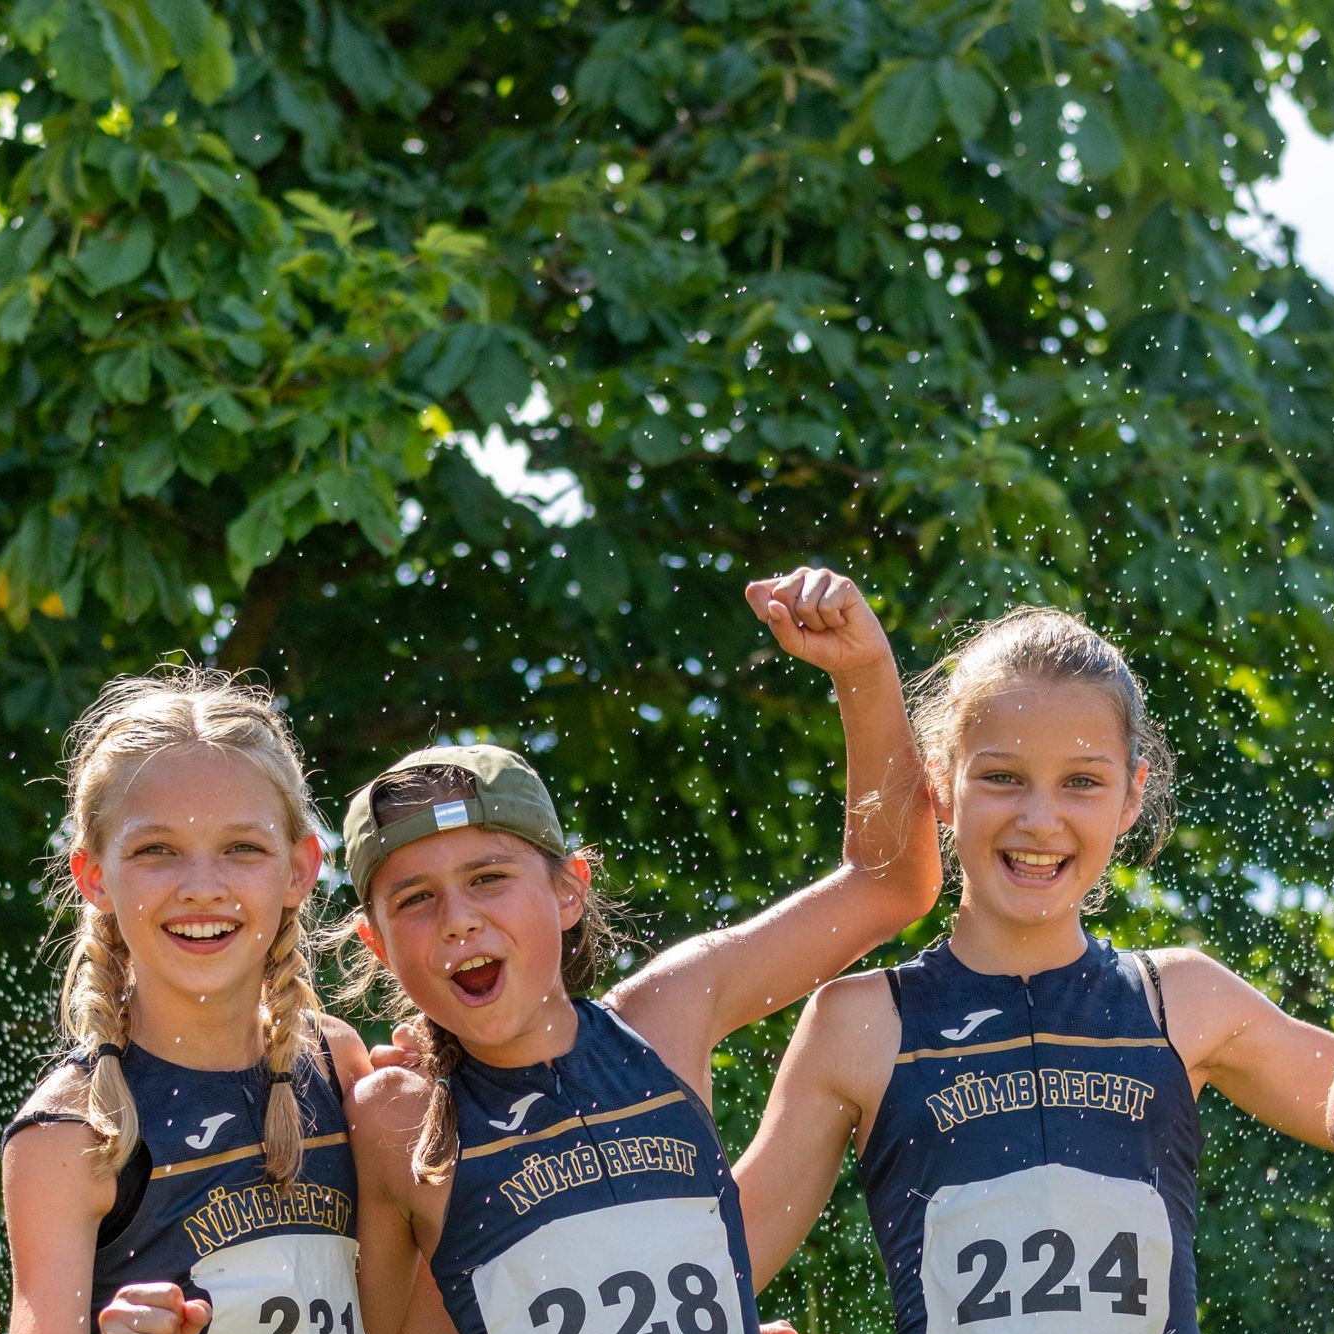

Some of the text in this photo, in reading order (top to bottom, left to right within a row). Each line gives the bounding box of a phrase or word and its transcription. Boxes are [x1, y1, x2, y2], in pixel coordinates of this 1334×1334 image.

[926, 1068, 1155, 1133] NÜMBRECHT
[499, 1137, 697, 1215] NÜMBRECHT
[956, 1229, 1148, 1326] 224
